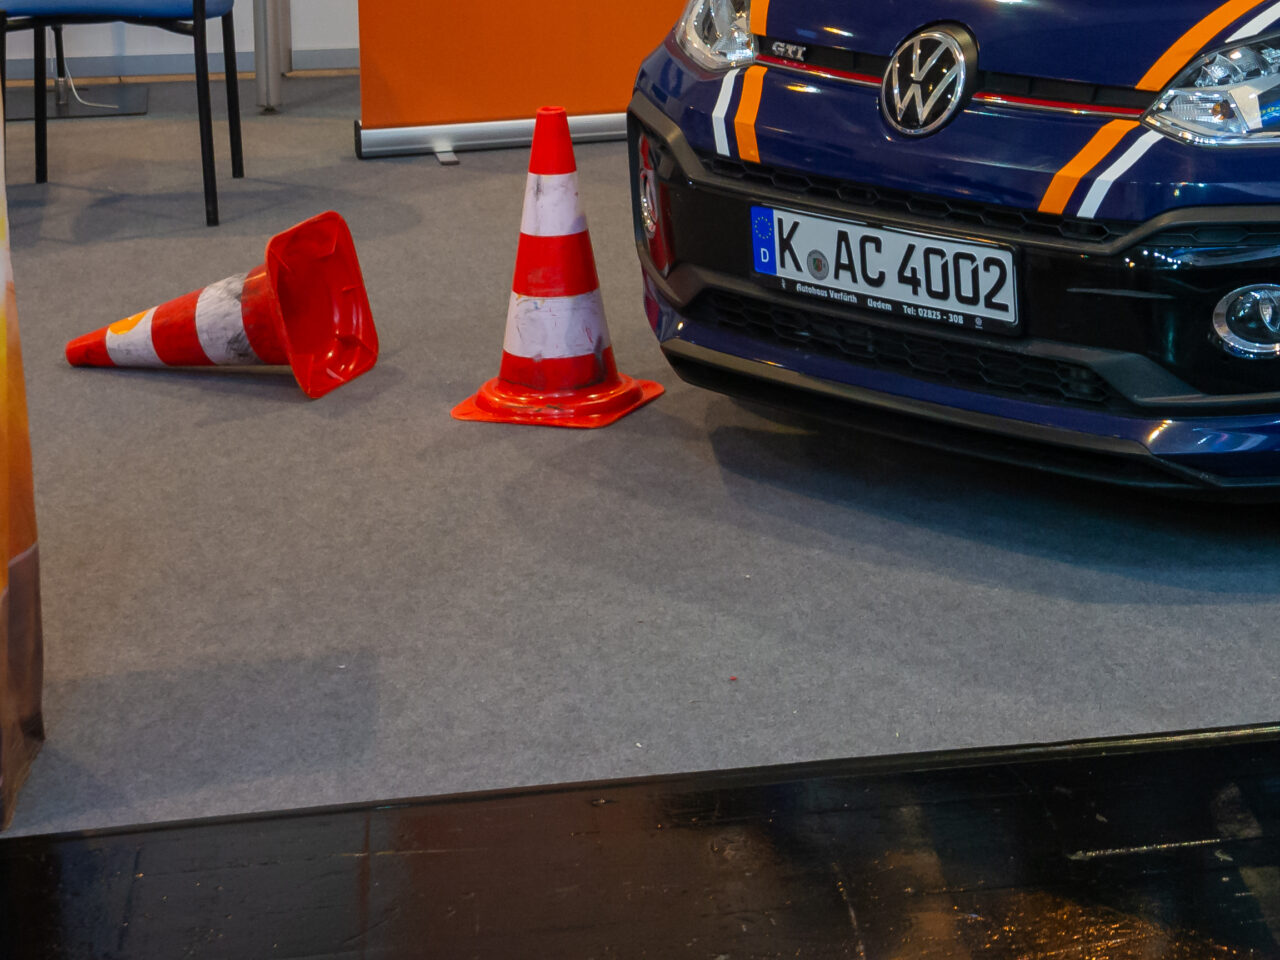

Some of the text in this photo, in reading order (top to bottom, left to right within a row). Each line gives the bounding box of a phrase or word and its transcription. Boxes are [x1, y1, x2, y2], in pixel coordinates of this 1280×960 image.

[772, 41, 806, 61] GTI
[760, 247, 770, 263] D
[777, 217, 1010, 313] K AC 4002
